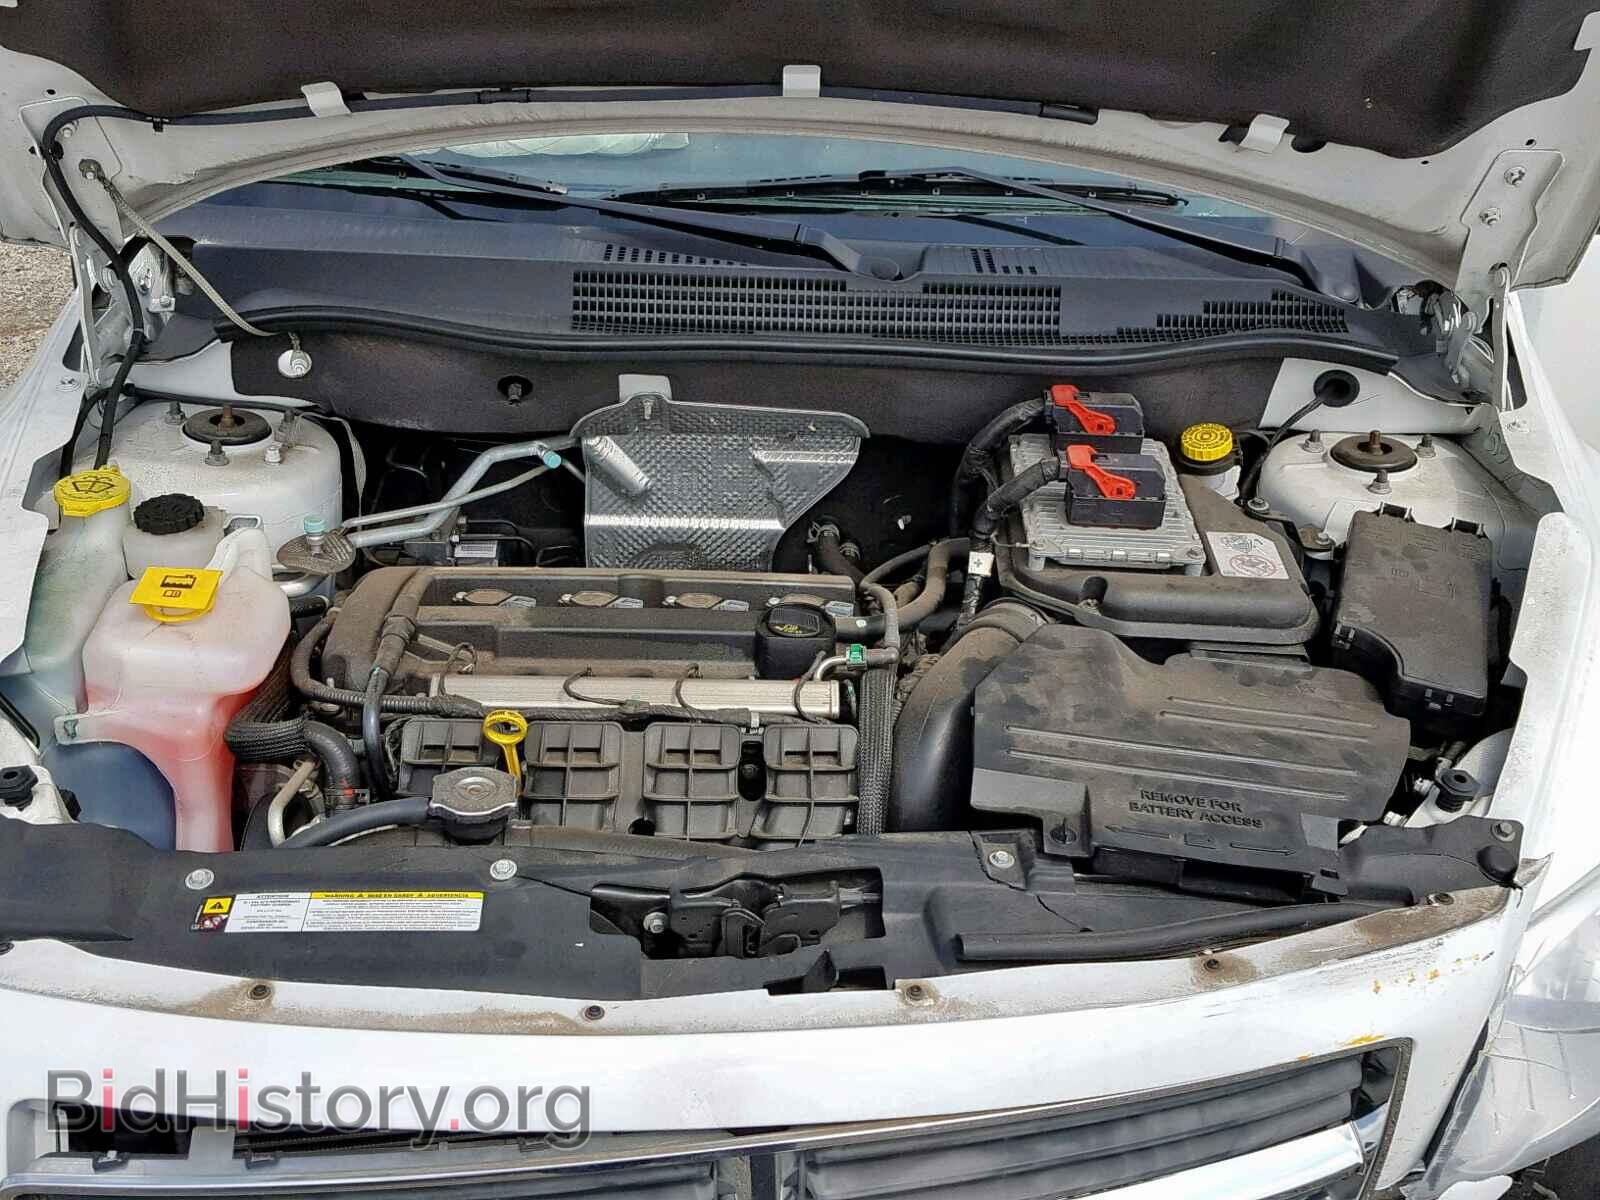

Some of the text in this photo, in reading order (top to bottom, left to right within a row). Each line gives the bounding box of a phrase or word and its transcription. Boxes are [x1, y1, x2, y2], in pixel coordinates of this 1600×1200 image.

[1140, 789, 1243, 813] REMOVE FOR
[1128, 801, 1263, 829] BATTERY ACCESS
